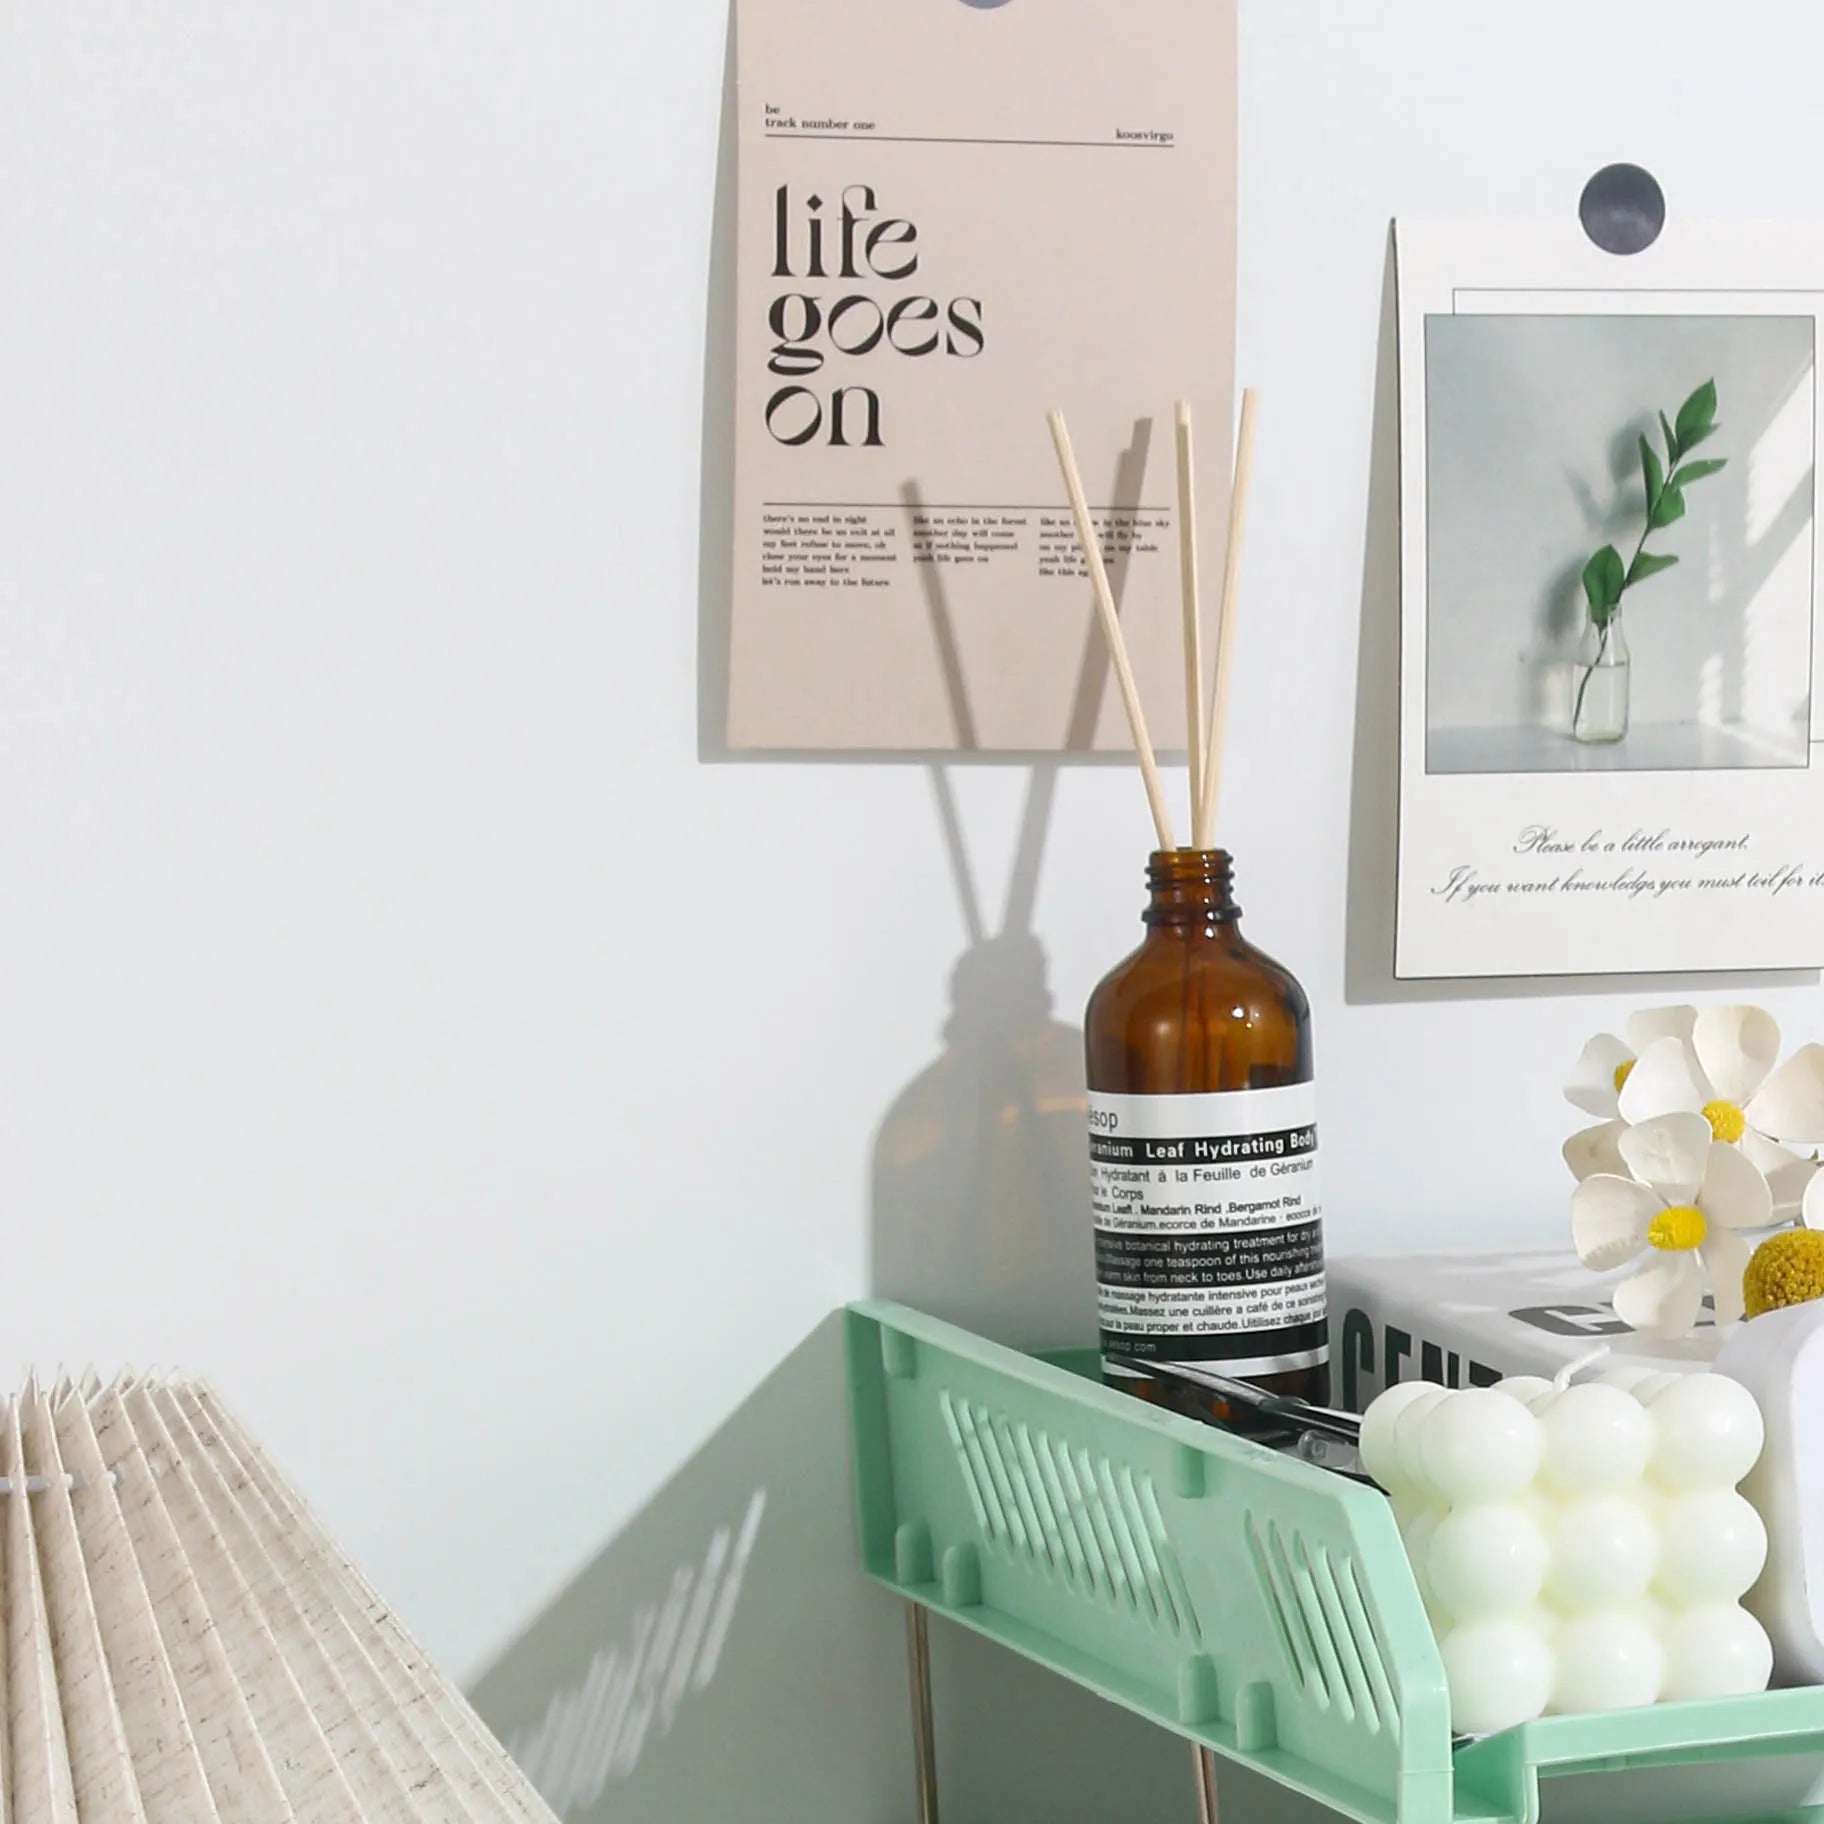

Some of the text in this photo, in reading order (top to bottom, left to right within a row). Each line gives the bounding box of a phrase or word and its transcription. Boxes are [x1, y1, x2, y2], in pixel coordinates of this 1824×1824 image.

[765, 103, 781, 115] be
[765, 117, 876, 130] track number one
[771, 183, 919, 281] life
[766, 293, 985, 376] goes
[764, 385, 885, 446] on
[1512, 824, 1575, 855] Please
[1581, 828, 1603, 853] be
[1602, 841, 1616, 853] a
[1621, 828, 1671, 853] little
[1461, 881, 1501, 903] you
[1506, 876, 1560, 894] want
[1652, 879, 1692, 898] you
[1697, 873, 1747, 889] must
[1771, 863, 1805, 897] for
[1145, 1141, 1185, 1160] Leaf
[1194, 1135, 1285, 1161] Hydrating
[1175, 1168, 1189, 1183] la
[1193, 1167, 1242, 1183] Feuille
[1249, 1166, 1267, 1178] de
[1111, 1186, 1145, 1202] Corps
[1140, 1204, 1191, 1216] Mandarin
[1195, 1202, 1222, 1215] Rind
[1200, 1217, 1216, 1229] de
[1173, 1239, 1230, 1254] hydrating
[1233, 1234, 1285, 1249] treatment
[1166, 1256, 1222, 1270] teaspoon
[1224, 1254, 1238, 1266] of
[1239, 1251, 1261, 1265] this
[1170, 1271, 1198, 1284] neck
[1201, 1271, 1215, 1284] to
[1148, 1290, 1206, 1304] hydratante
[1208, 1289, 1259, 1302] intensive
[1260, 1286, 1283, 1300] pour
[1168, 1308, 1190, 1318] une
[1246, 1301, 1269, 1314] café
[1271, 1299, 1284, 1312] de
[1146, 1319, 1195, 1334] proper et
